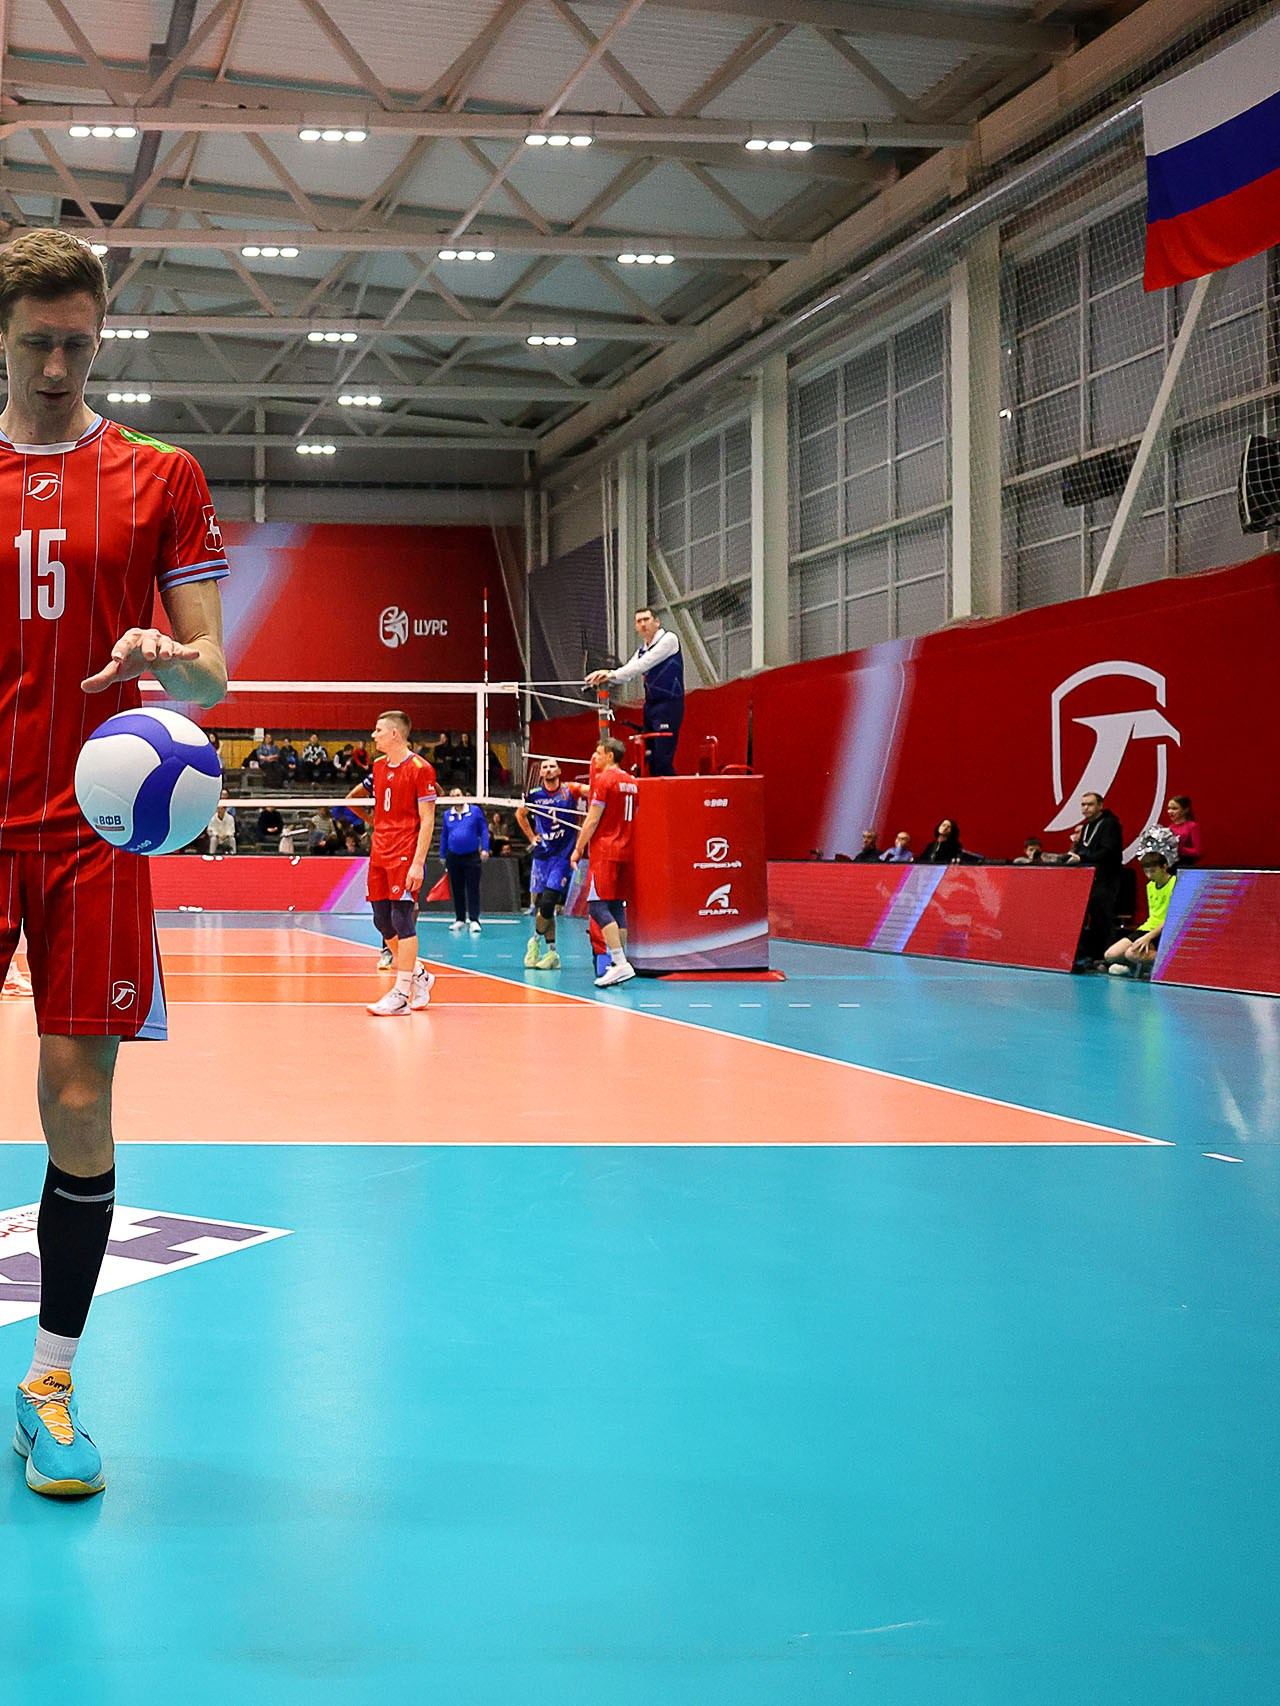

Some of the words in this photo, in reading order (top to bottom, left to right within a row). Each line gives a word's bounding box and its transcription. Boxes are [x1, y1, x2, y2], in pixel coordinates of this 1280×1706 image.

[14, 528, 67, 620] 15
[413, 619, 448, 636] ЦУРС
[384, 787, 392, 812] 8
[624, 794, 633, 821] 11
[98, 815, 122, 825] ВФВ
